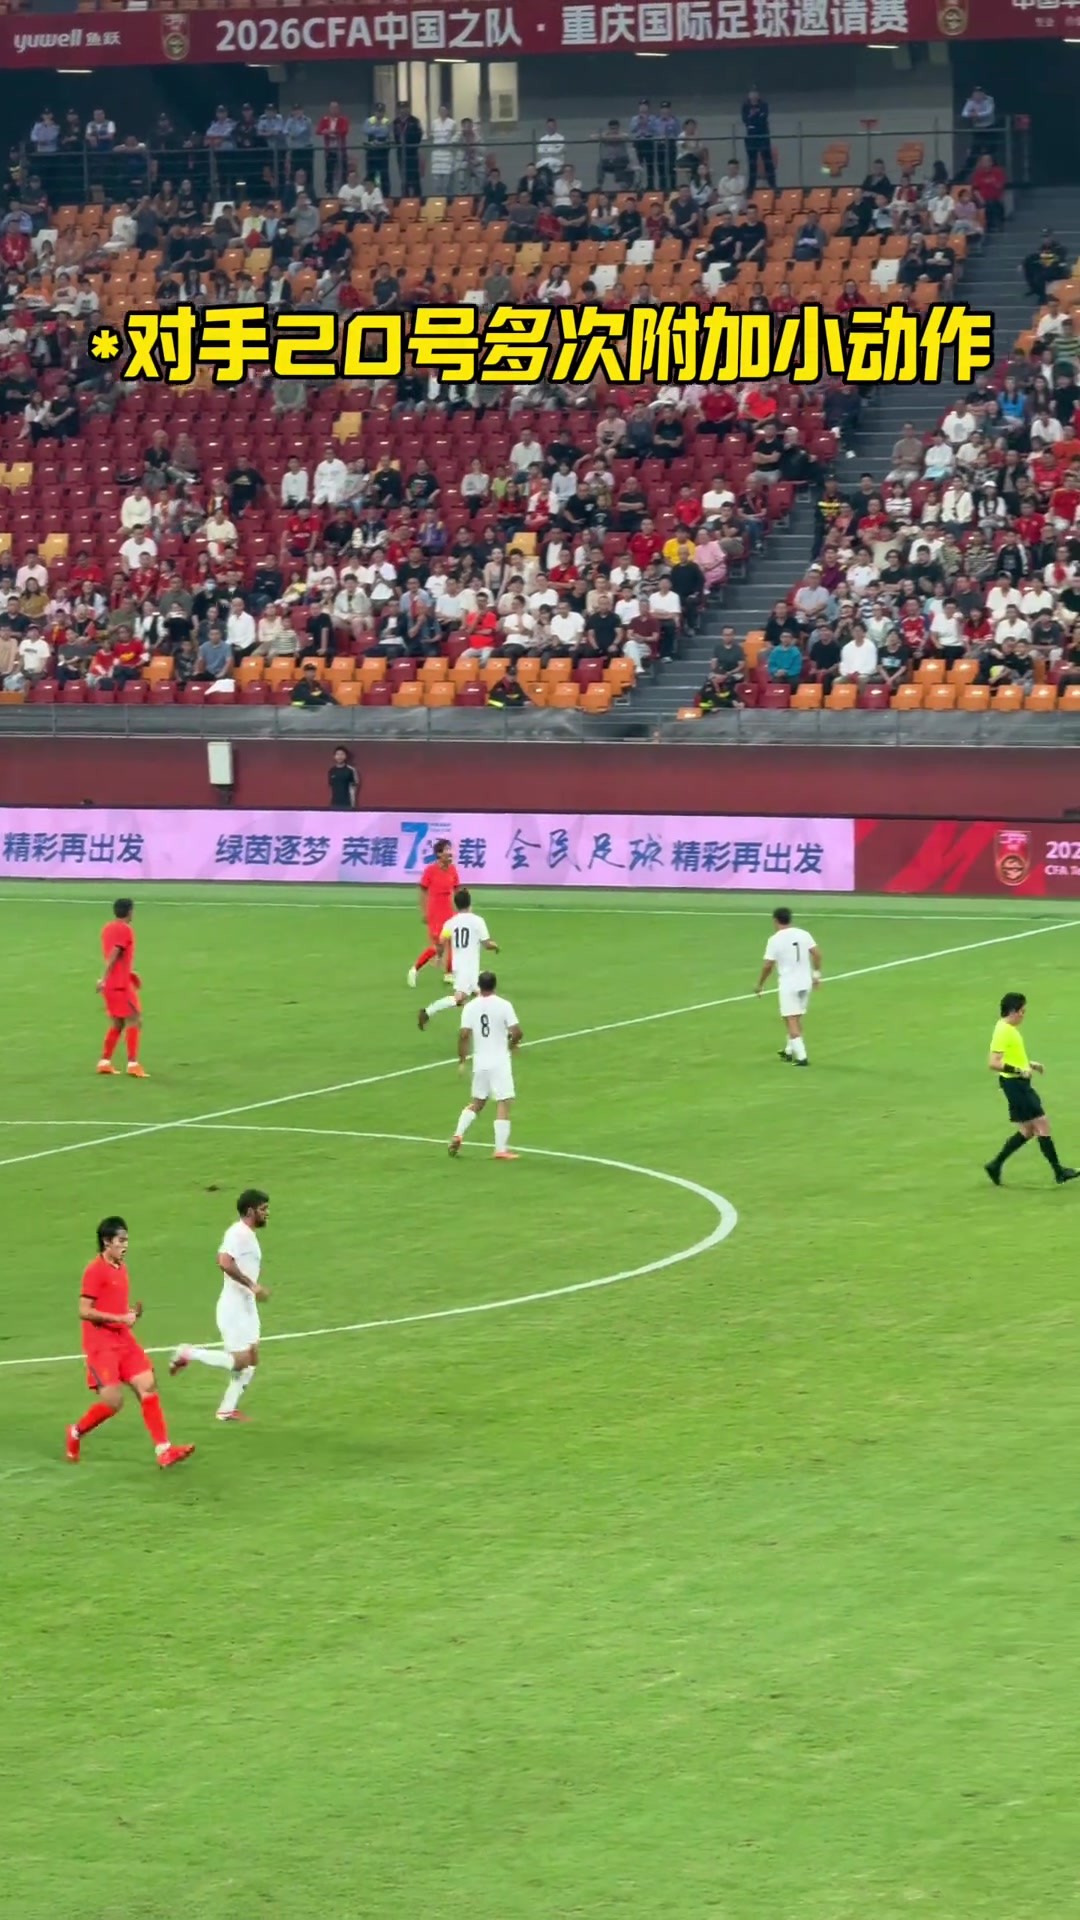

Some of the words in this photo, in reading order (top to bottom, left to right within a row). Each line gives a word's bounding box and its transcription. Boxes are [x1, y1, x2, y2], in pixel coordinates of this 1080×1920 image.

[216, 8, 522, 51] 2026CFA中国之队
[561, 0, 908, 46] 重庆国际足球邀请赛
[13, 28, 83, 54] yuwell
[2, 832, 145, 864] 精彩再出发
[215, 834, 331, 866] 绿茵逐梦
[671, 840, 824, 875] 精彩再出发
[454, 926, 470, 949] 10
[480, 1013, 490, 1038] 8
